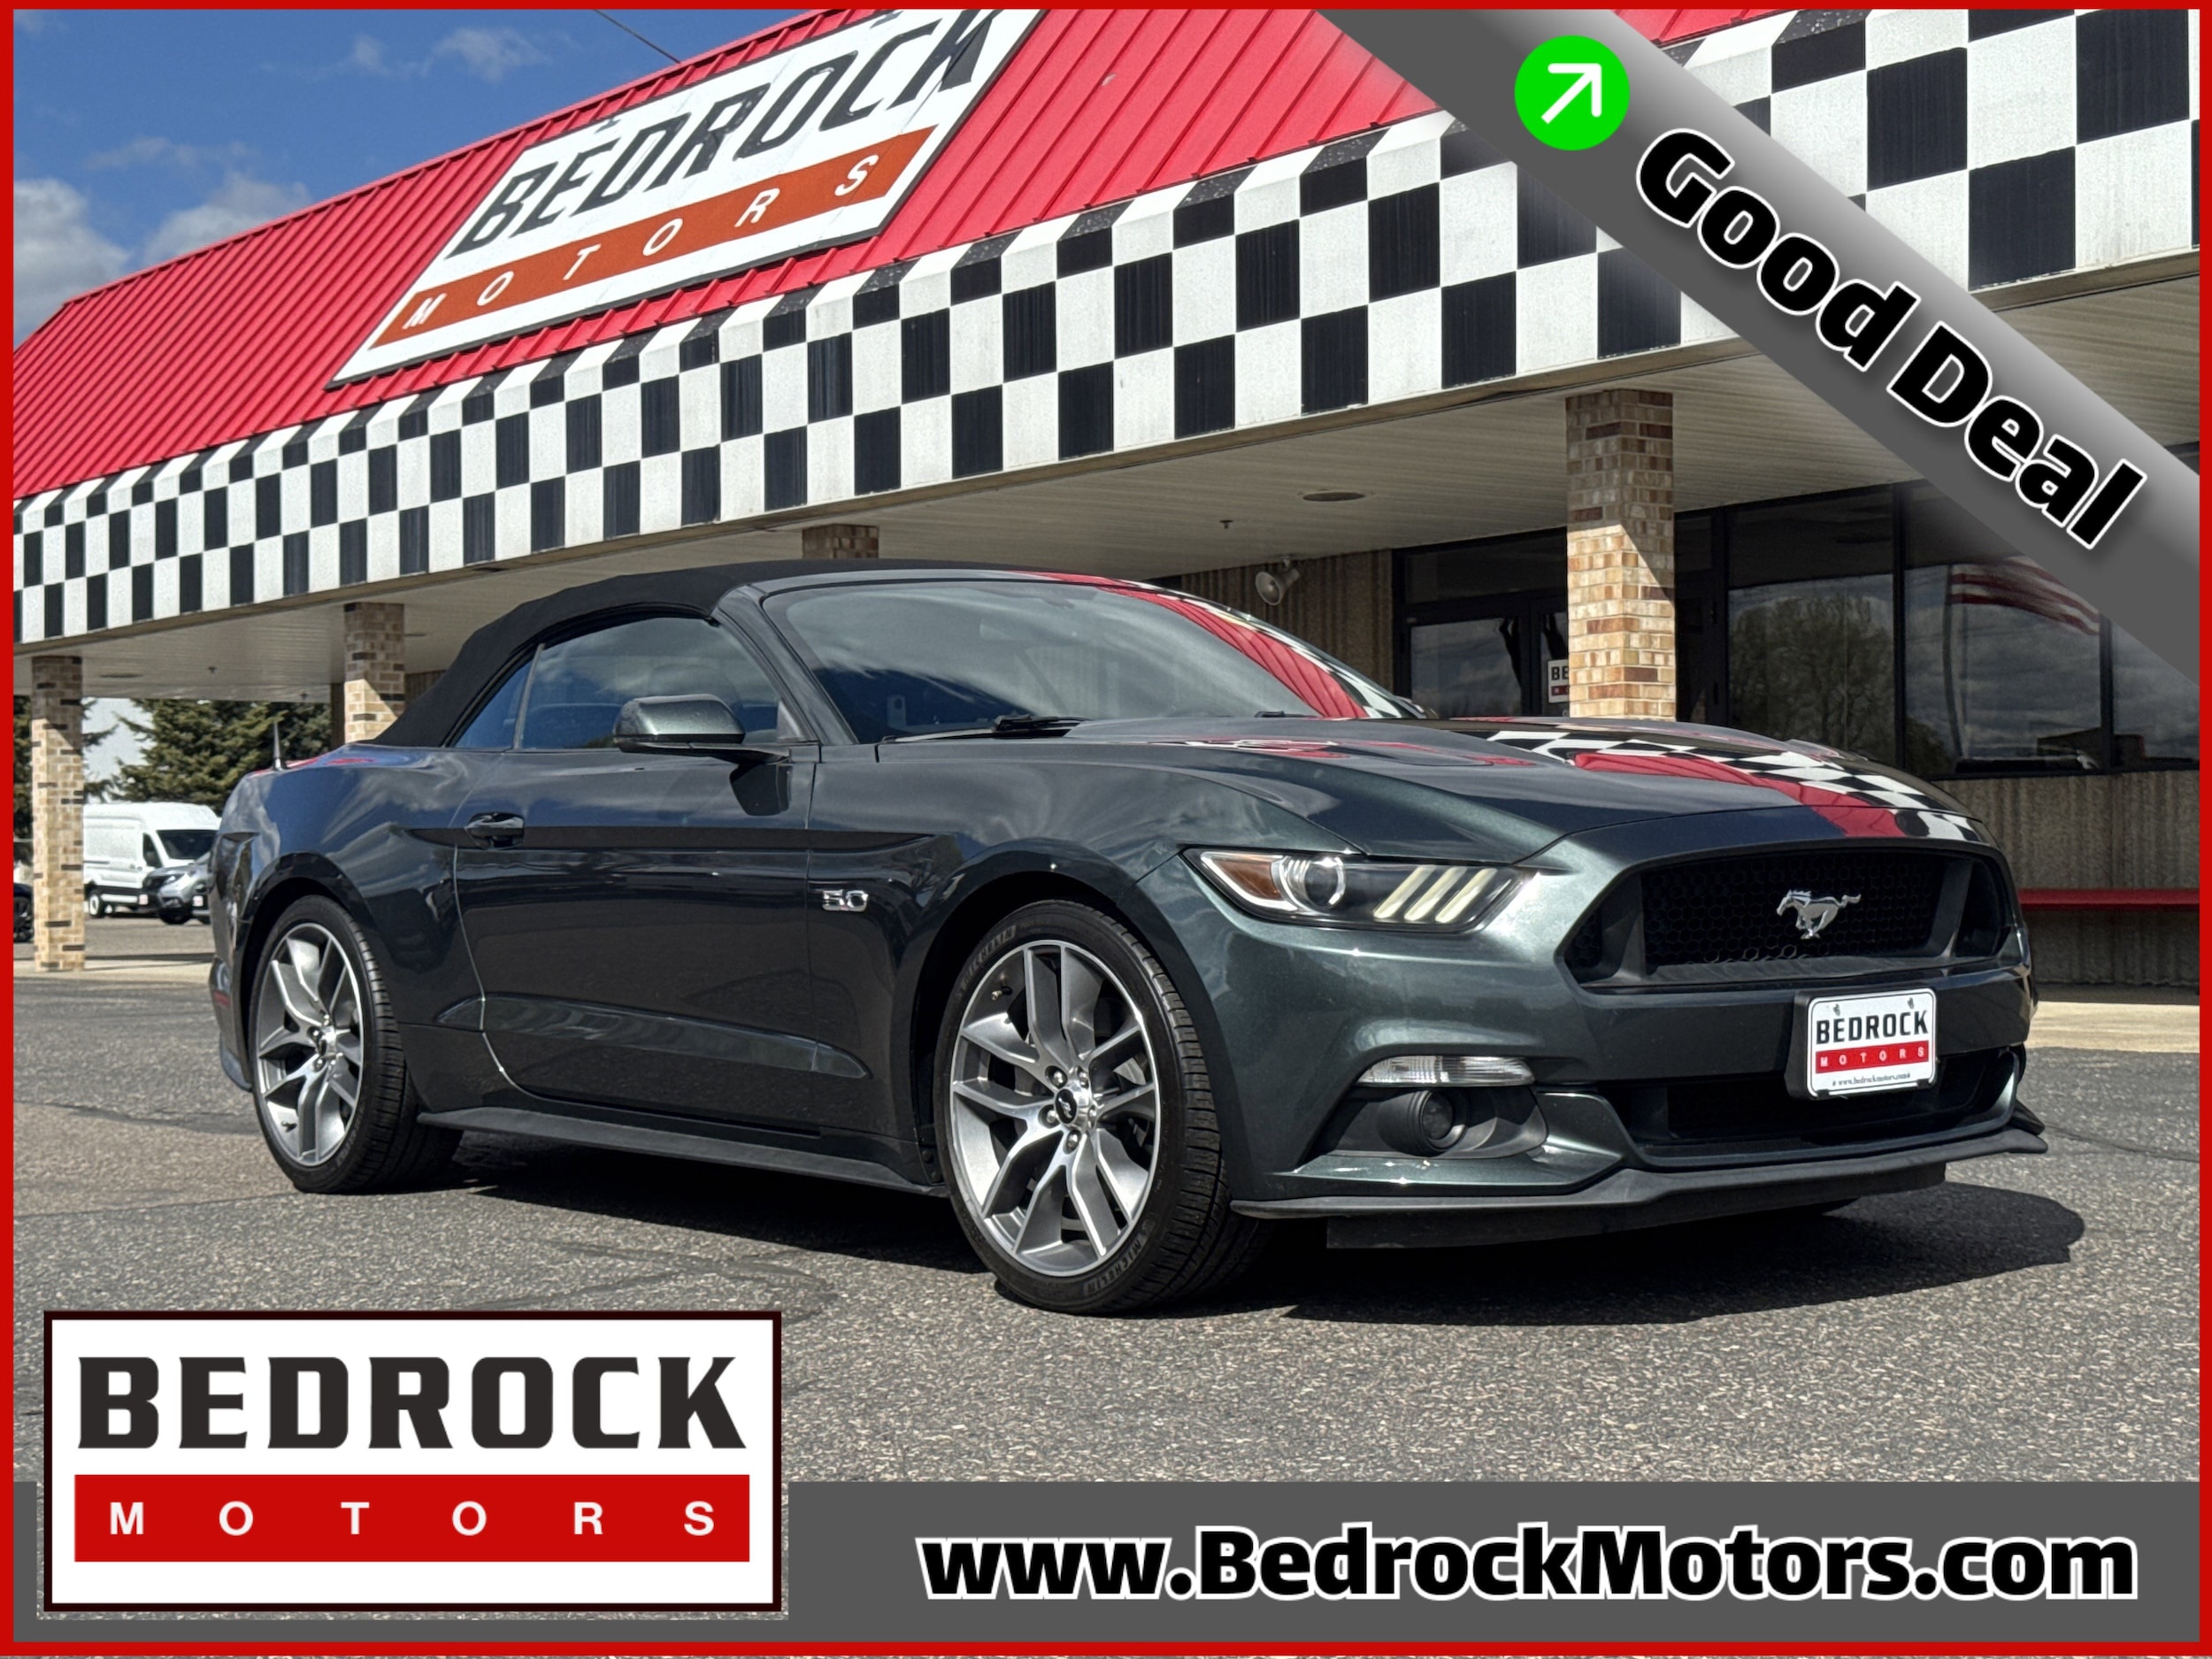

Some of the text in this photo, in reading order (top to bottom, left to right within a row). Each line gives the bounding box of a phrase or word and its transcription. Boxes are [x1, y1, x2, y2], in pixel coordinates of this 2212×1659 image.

[446, 9, 999, 258] BEDROCK
[402, 154, 879, 329] MOTORS
[1816, 1010, 1929, 1044] BEDROCK
[1820, 1046, 1924, 1067] MOTORS
